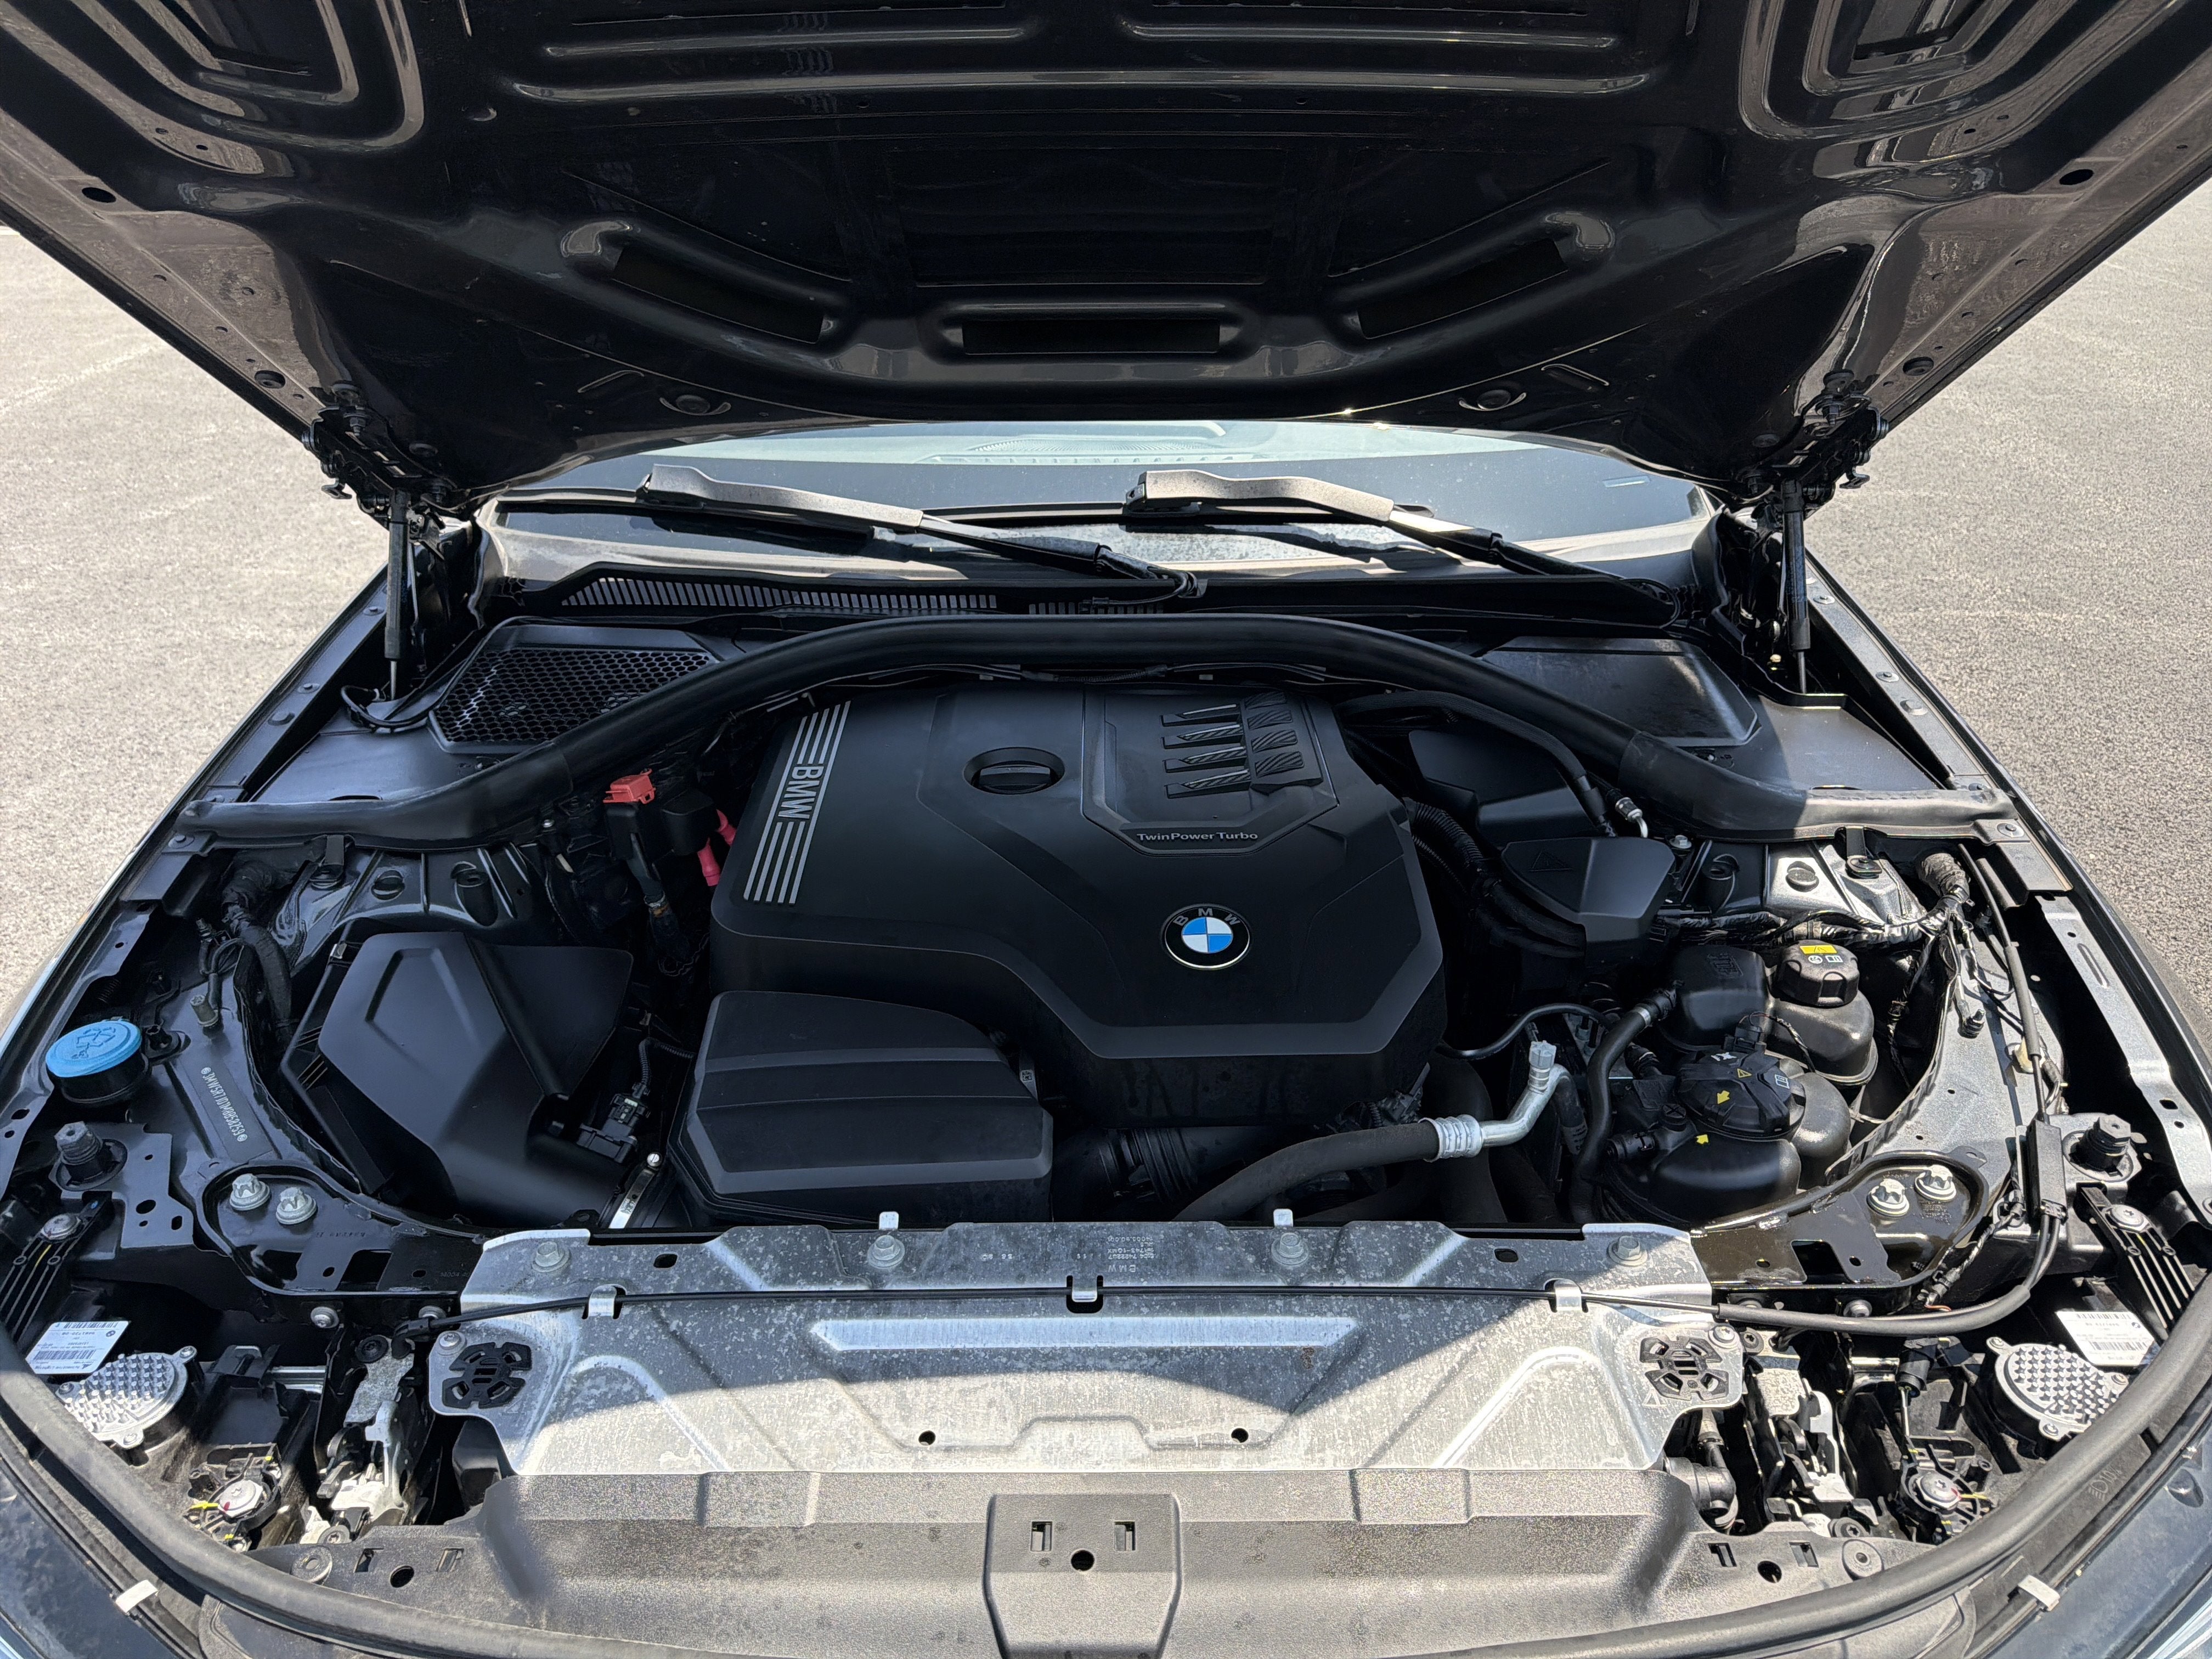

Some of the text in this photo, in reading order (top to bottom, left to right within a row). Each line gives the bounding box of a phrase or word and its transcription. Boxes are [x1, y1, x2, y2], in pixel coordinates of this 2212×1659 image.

[778, 766, 824, 819] BMW
[1172, 907, 1241, 927] BMW
[1108, 1264, 1136, 1273] BMW
